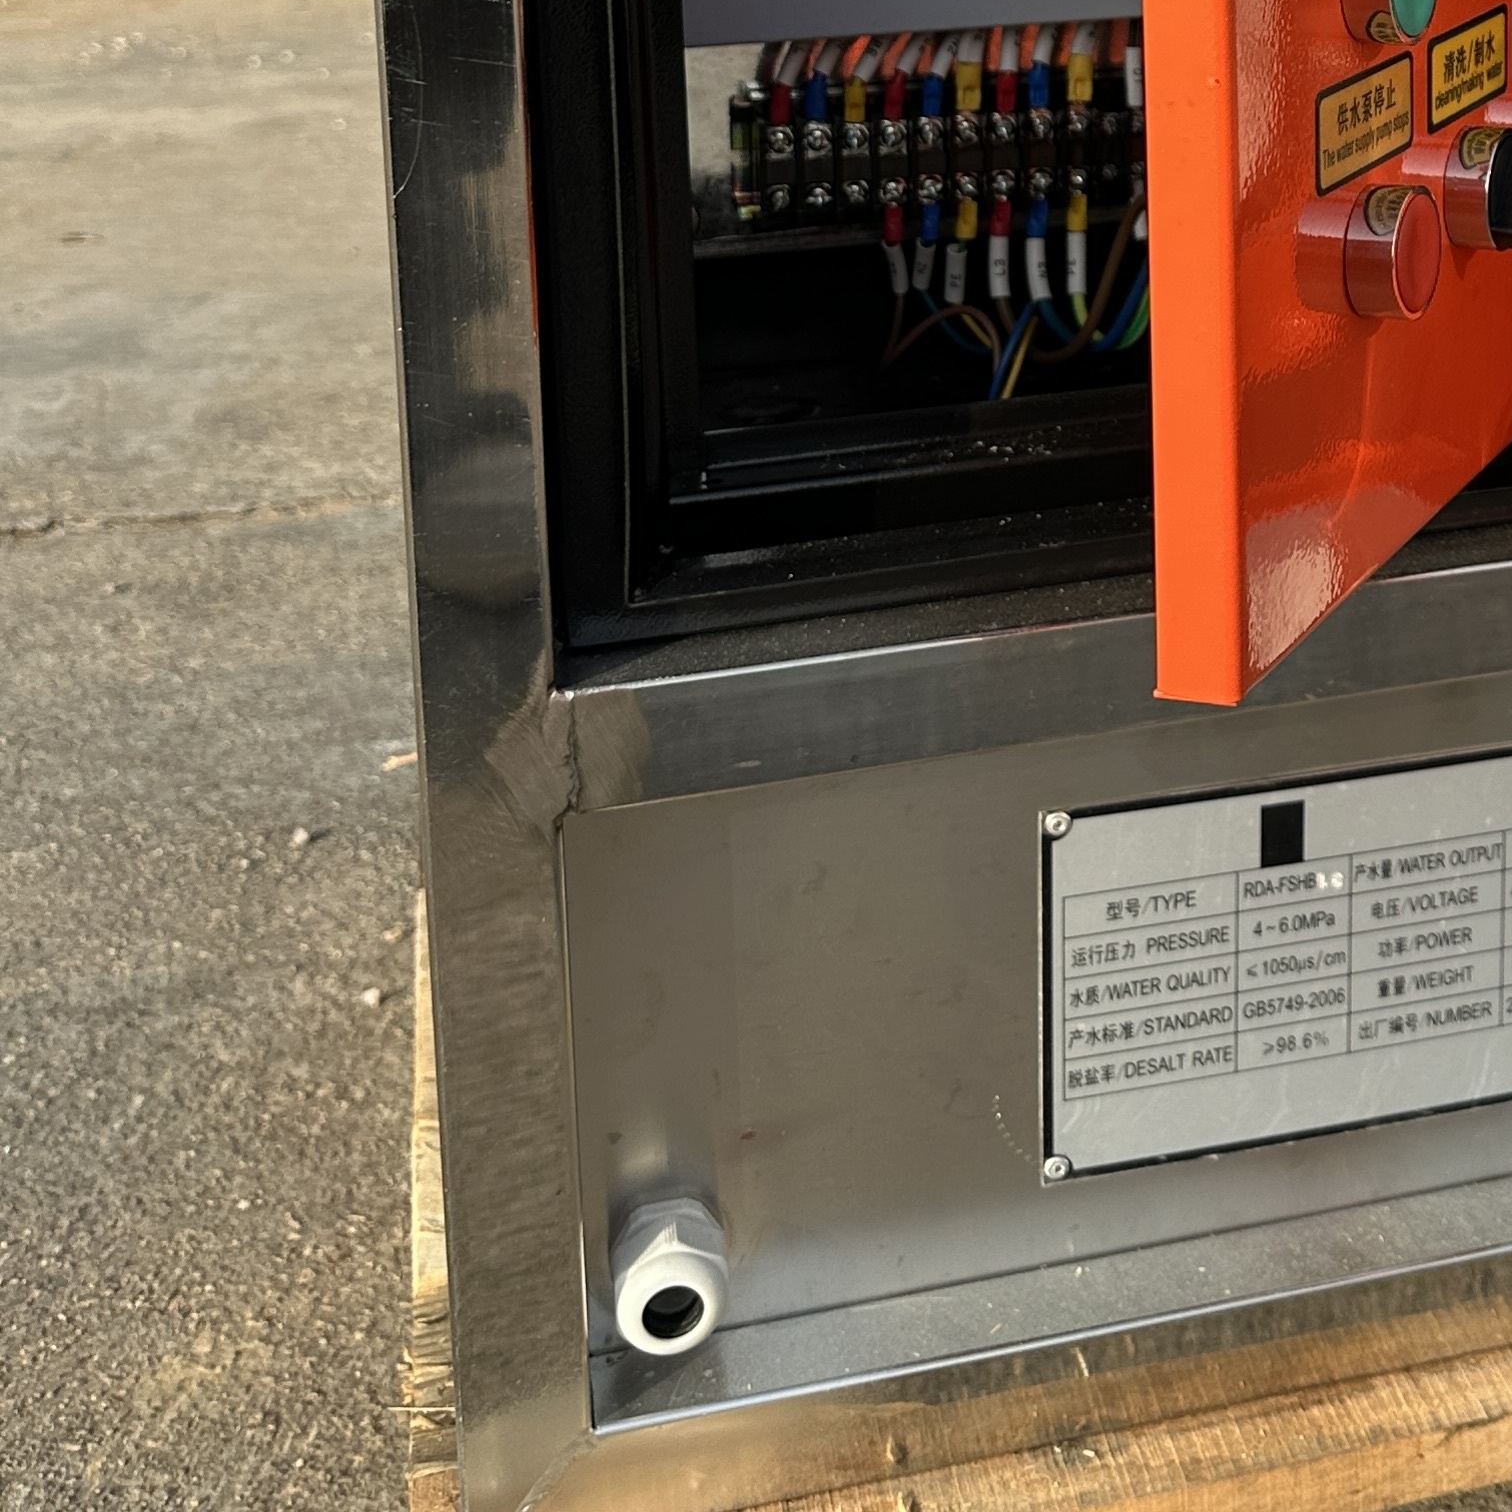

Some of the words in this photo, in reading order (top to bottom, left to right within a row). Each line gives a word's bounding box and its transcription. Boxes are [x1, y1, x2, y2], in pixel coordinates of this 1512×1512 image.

[1443, 29, 1496, 84] 清洗/制水
[1337, 77, 1397, 136] 供水泵停止
[1322, 148, 1336, 170] The
[1449, 842, 1503, 867] OUTPUT
[1106, 889, 1197, 921] 型号/TYPE
[1071, 940, 1136, 968] 运行压力
[1146, 925, 1231, 955] PRESSURE
[1166, 965, 1232, 993] QUALITY
[1242, 986, 1347, 1021] GB5749-2006
[1192, 1044, 1233, 1068] RATE
